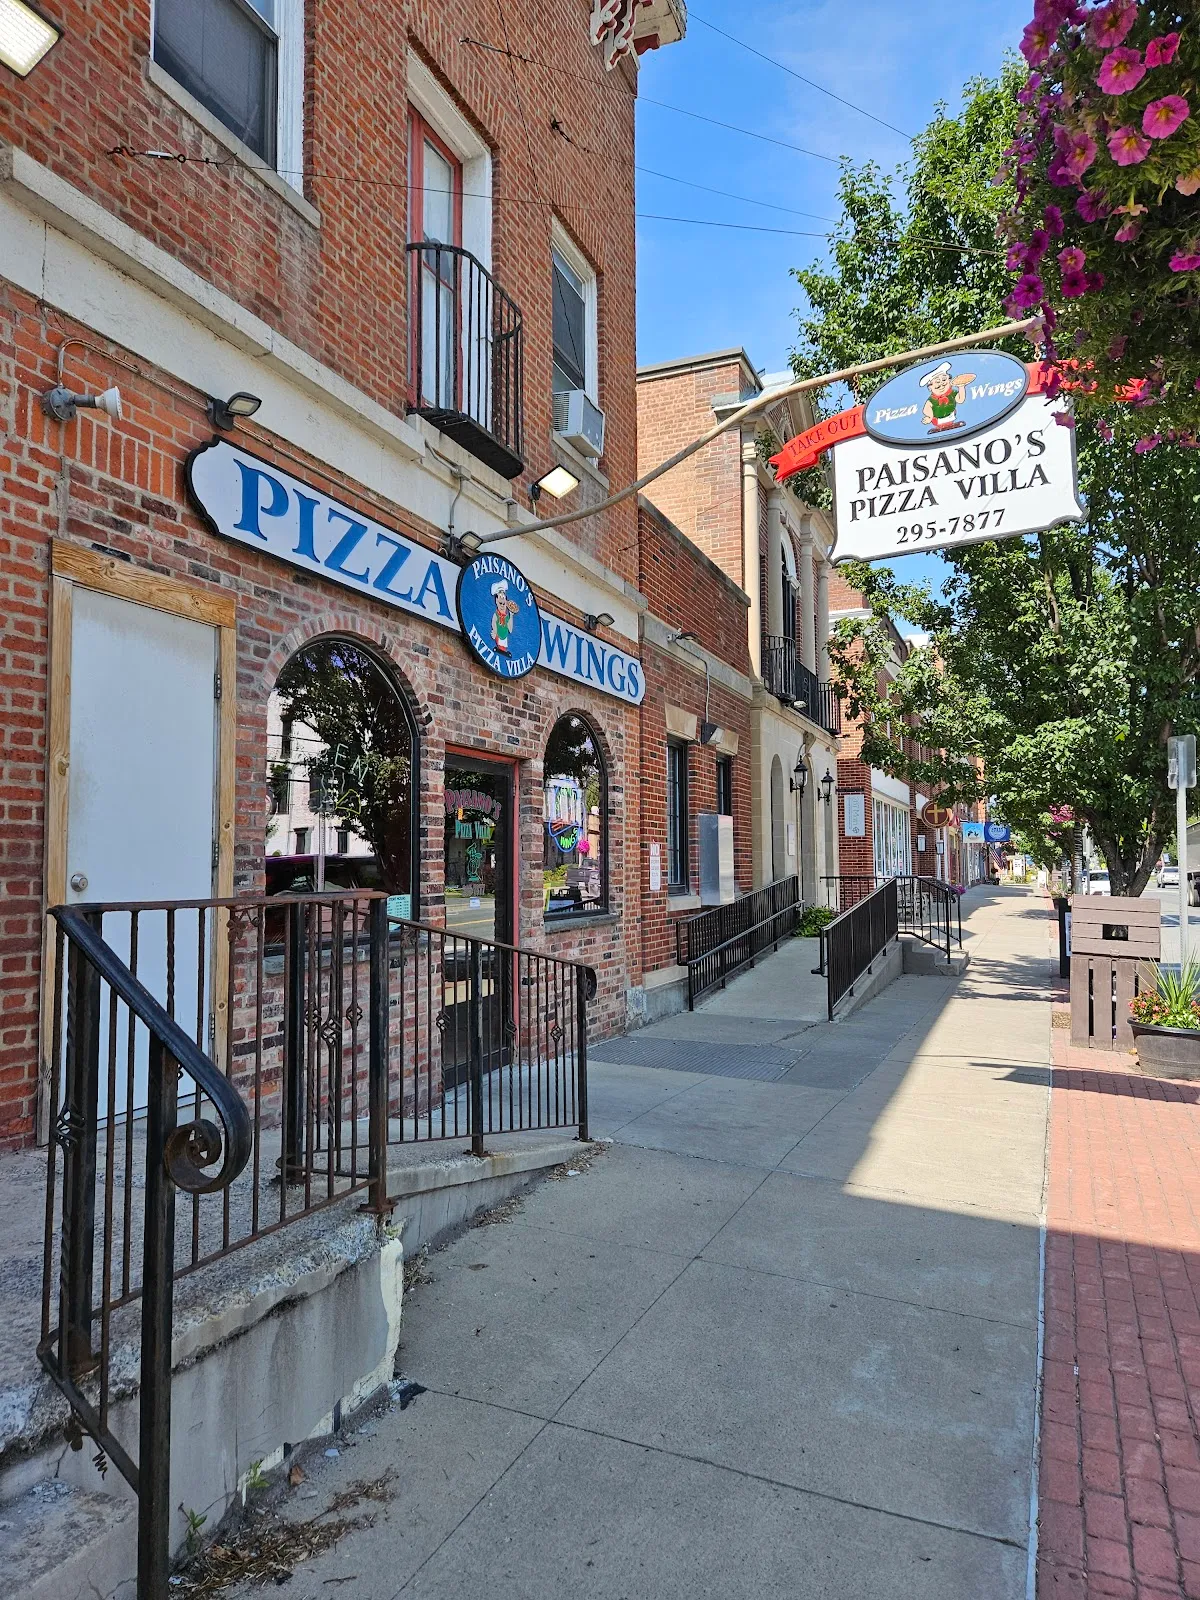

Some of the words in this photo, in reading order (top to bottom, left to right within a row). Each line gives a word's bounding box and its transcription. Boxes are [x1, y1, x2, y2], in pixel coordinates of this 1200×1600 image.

[874, 403, 918, 424] Pizza
[970, 378, 1023, 400] Wings
[788, 428, 825, 457] TAKE
[827, 413, 860, 435] OUT
[856, 429, 1046, 493] PAISANO'S
[849, 485, 939, 522] PIZZA
[954, 463, 1051, 500] VILLA
[233, 458, 454, 621] PIZZA
[896, 508, 1006, 544] 295-7877
[472, 556, 534, 607] PAISANO'S
[469, 623, 502, 673] PIZZA
[506, 651, 535, 676] VILLA
[540, 617, 639, 698] WINGS
